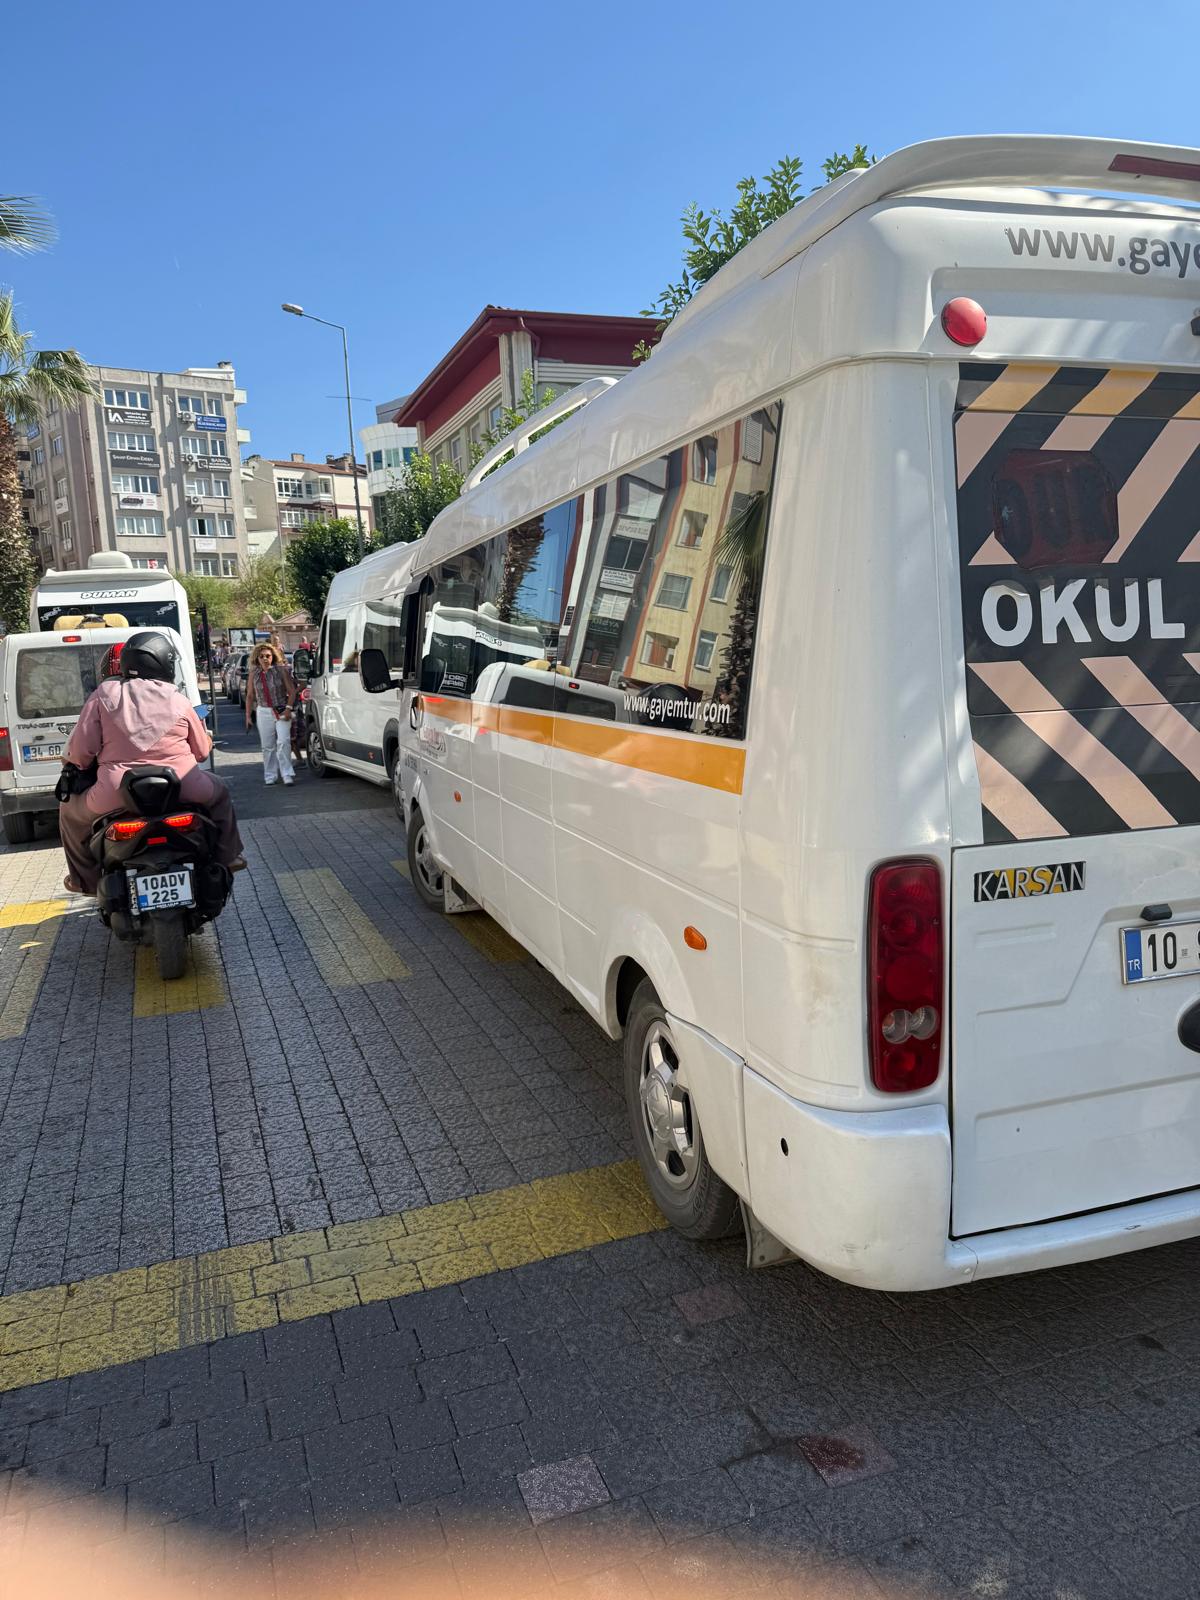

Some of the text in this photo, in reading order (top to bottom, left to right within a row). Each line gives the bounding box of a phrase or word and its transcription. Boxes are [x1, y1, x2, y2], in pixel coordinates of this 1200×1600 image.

[81, 590, 138, 599] DUMAN
[981, 577, 1185, 647] OKUL
[623, 694, 731, 724] www.gayemtur.com
[31, 747, 43, 758] 34
[142, 873, 185, 891] 10ADV
[977, 861, 1086, 901] KARSAN
[151, 889, 179, 903] 225
[1128, 959, 1141, 971] TR
[1148, 931, 1177, 972] 10
